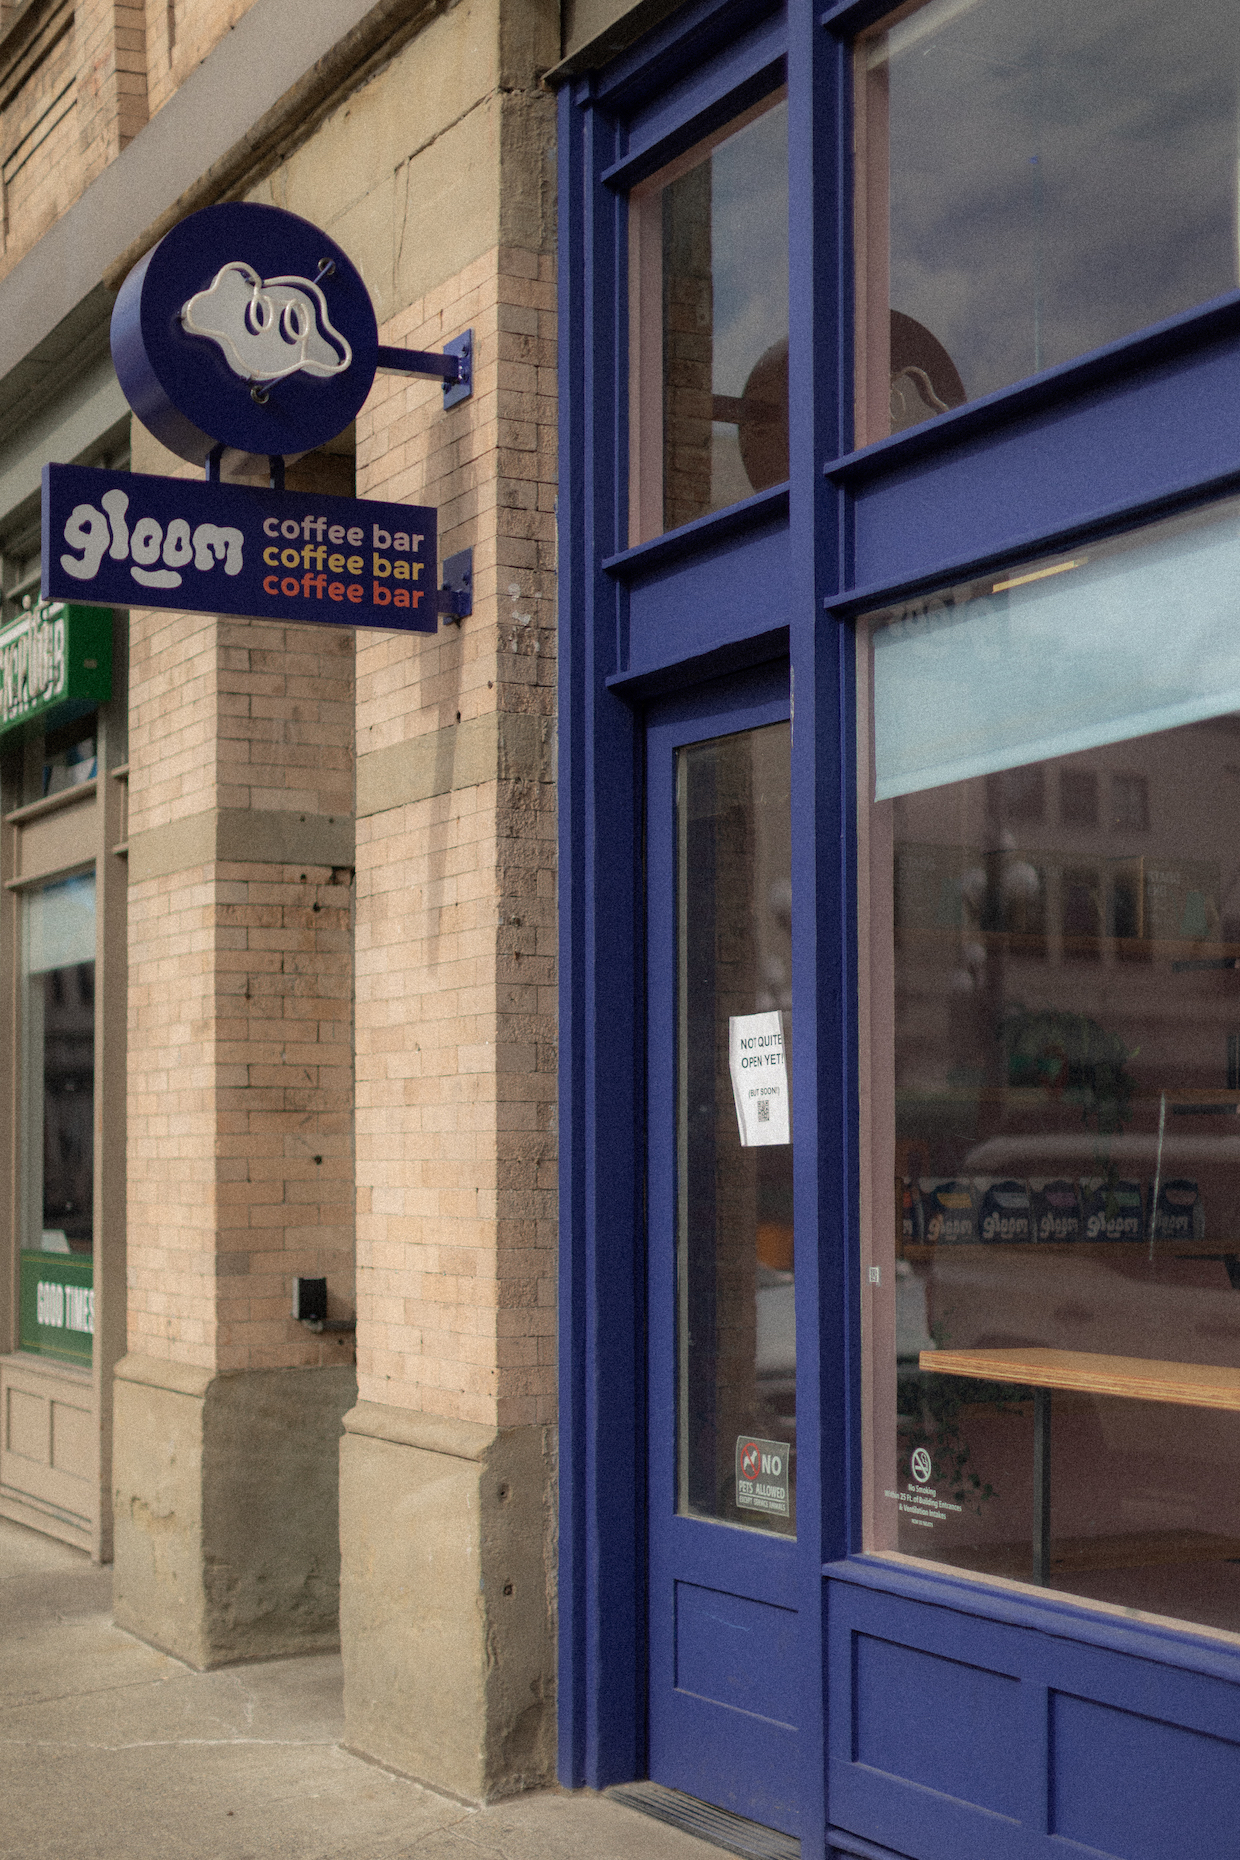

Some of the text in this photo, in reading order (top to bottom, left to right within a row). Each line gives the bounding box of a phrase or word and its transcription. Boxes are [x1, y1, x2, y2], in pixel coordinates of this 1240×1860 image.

[60, 489, 244, 588] gloom
[263, 515, 424, 552] coffee bar
[263, 544, 424, 580] coffee bar
[263, 573, 424, 609] coffee bar
[740, 1033, 782, 1050] NOT QUITE
[741, 1056, 763, 1069] OPEN
[982, 1211, 1028, 1239] gloom
[1086, 1211, 1138, 1238] gloom
[761, 1454, 782, 1476] NO
[739, 1480, 786, 1499] PETS ALLOWED
[884, 1490, 900, 1500] Within
[919, 1497, 938, 1508] Building
[939, 1500, 962, 1512] Entrances
[908, 1484, 937, 1497] No Smoking
